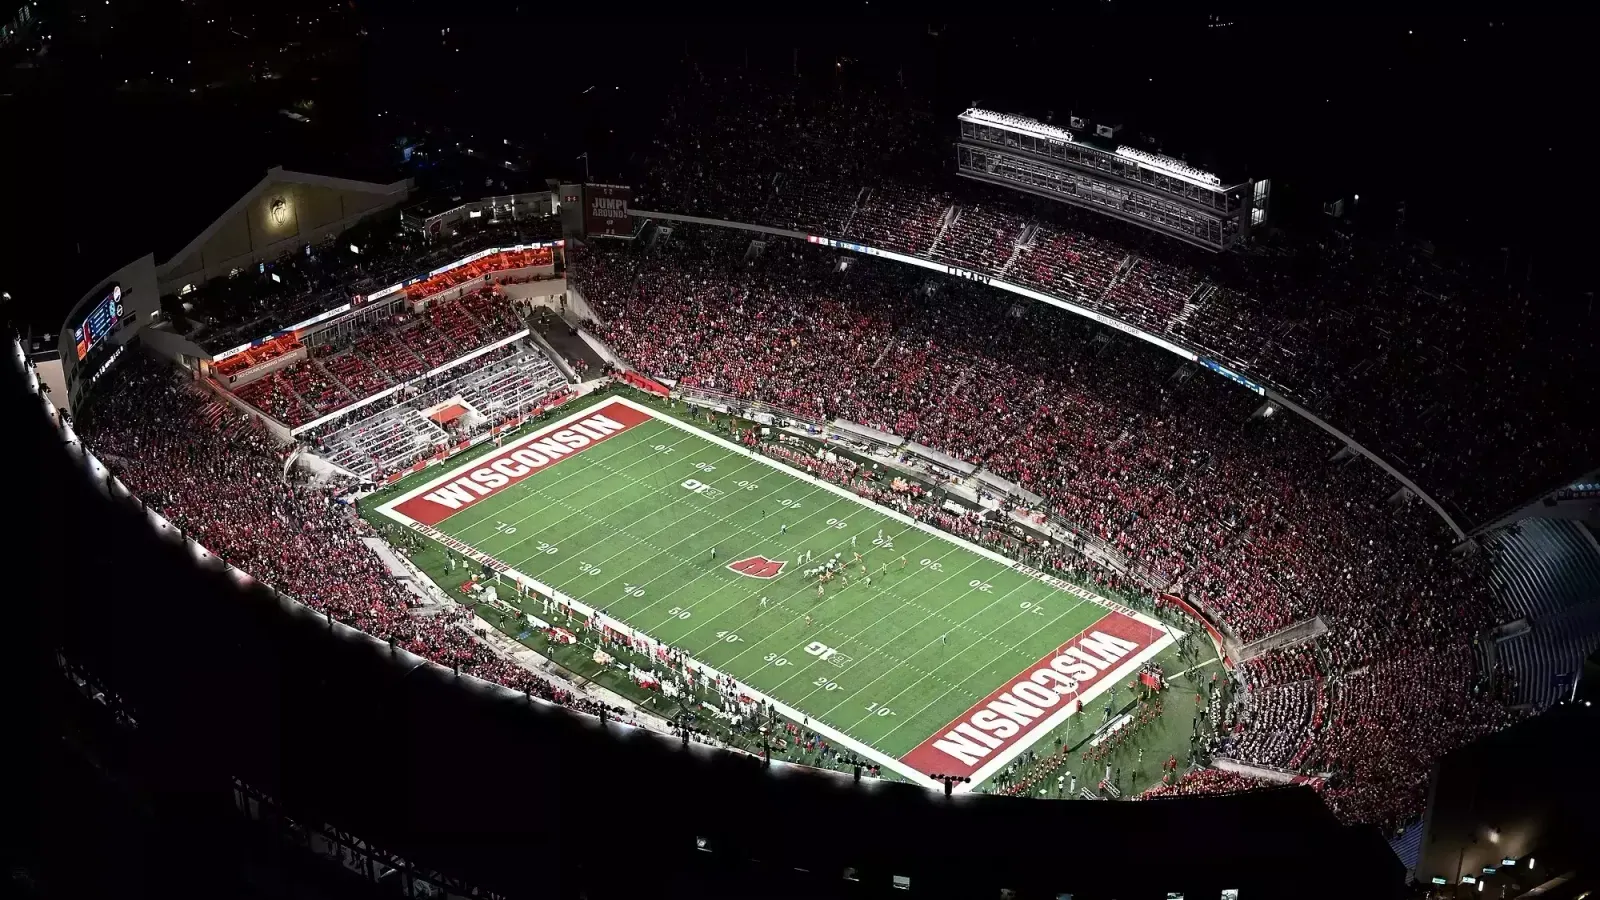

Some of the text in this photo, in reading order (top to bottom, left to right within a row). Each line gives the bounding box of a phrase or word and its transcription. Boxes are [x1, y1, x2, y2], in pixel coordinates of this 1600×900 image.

[654, 444, 674, 455] 10
[424, 414, 626, 510] WISCONSIN
[696, 462, 716, 473] 20
[738, 480, 758, 491] 30
[782, 499, 801, 509] 40
[495, 521, 516, 534] 10
[826, 518, 848, 530] 50
[536, 542, 559, 556] 20
[580, 562, 602, 576] 30
[920, 558, 941, 571] 30
[624, 584, 646, 598] 40
[969, 579, 992, 592] 20
[668, 607, 691, 620] 50
[1020, 602, 1043, 614] 10
[715, 631, 739, 643] 40
[763, 652, 789, 667] 30
[813, 677, 839, 691] 20
[932, 630, 1140, 767] WISCONSIN
[865, 702, 891, 717] 10
